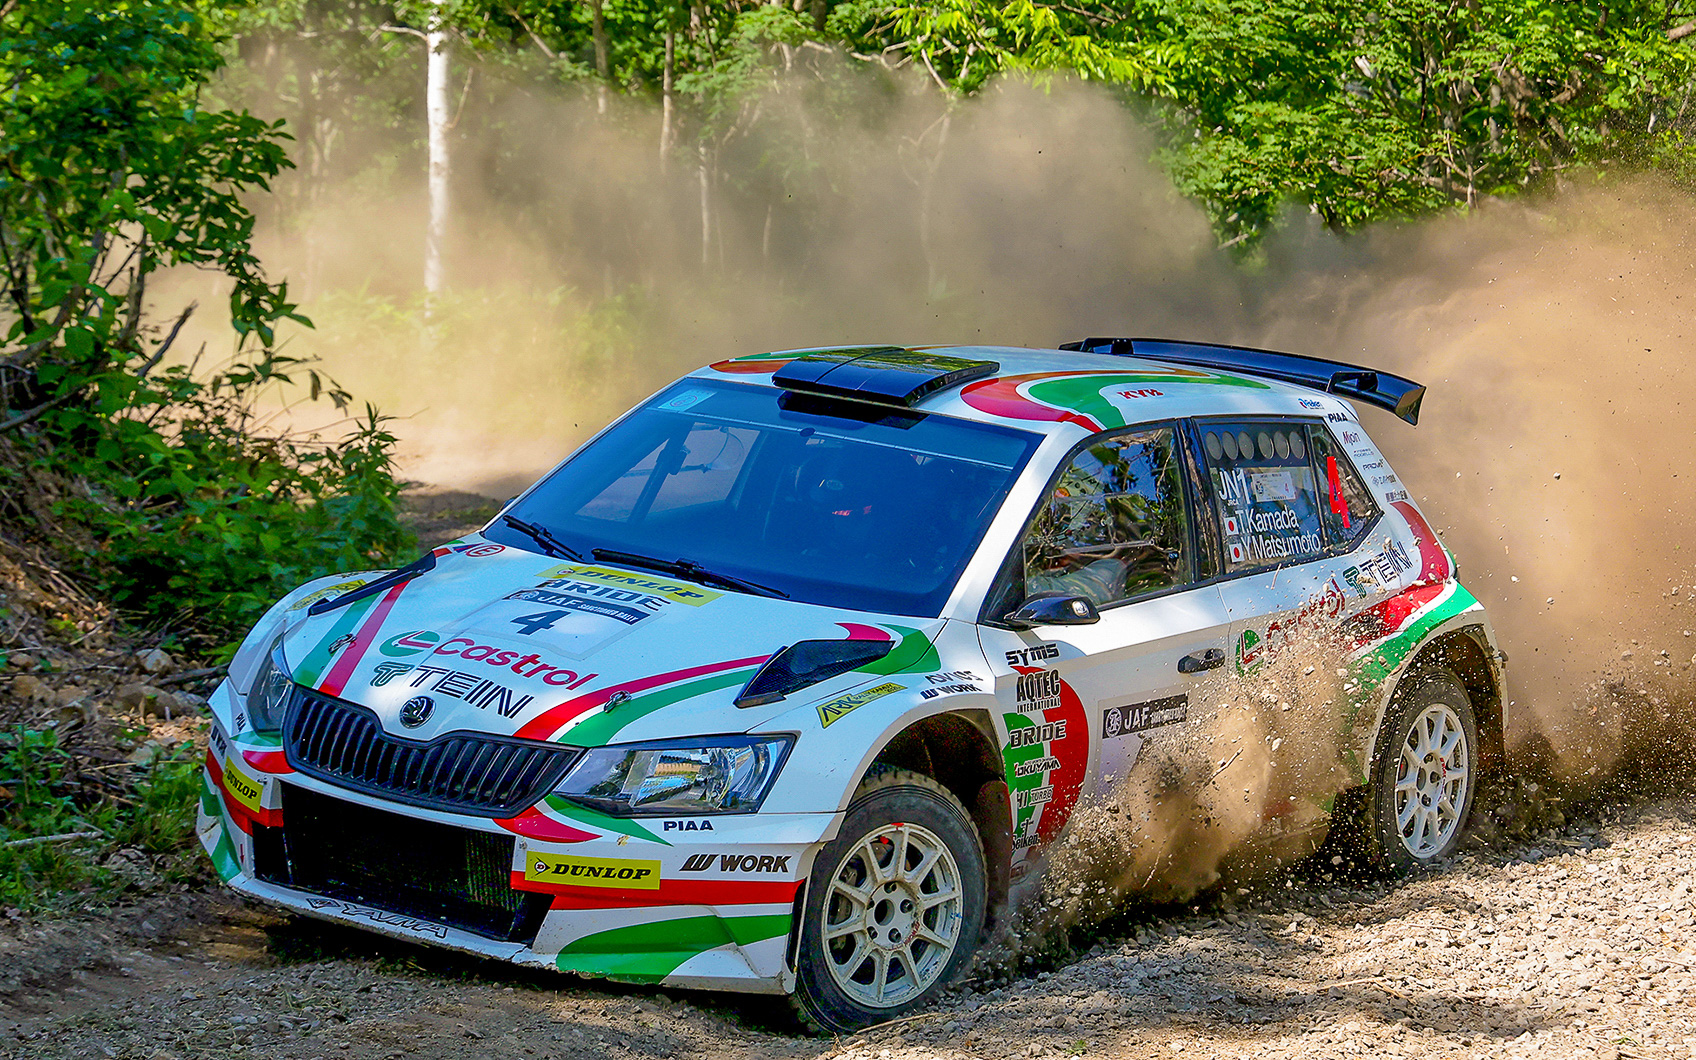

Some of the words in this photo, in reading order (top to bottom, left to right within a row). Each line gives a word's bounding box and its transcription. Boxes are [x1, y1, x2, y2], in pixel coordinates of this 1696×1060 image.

[1327, 412, 1348, 423] PIAA
[1218, 468, 1251, 504] JN1
[1327, 456, 1350, 528] 4
[1234, 504, 1300, 534] T.Kamada
[535, 578, 671, 612] BRIDE
[578, 570, 704, 599] DUNLOP
[537, 595, 583, 607] JAF
[510, 609, 571, 636] 4
[433, 638, 599, 690] Castrol
[409, 664, 535, 719] TEIN
[937, 683, 983, 694] WORK
[1016, 669, 1061, 703] AQTEC
[821, 696, 864, 722] ARK
[1017, 697, 1061, 714] INTERNATIONAL
[1124, 706, 1150, 730] JAF
[1009, 720, 1067, 748] BRIDE
[1017, 759, 1060, 777] OKUYAMA
[226, 770, 257, 799] DUNLOP
[1030, 788, 1052, 803] TURBO
[663, 820, 714, 831] PIAA
[551, 863, 652, 880] DUNLOP
[720, 855, 792, 873] WORK
